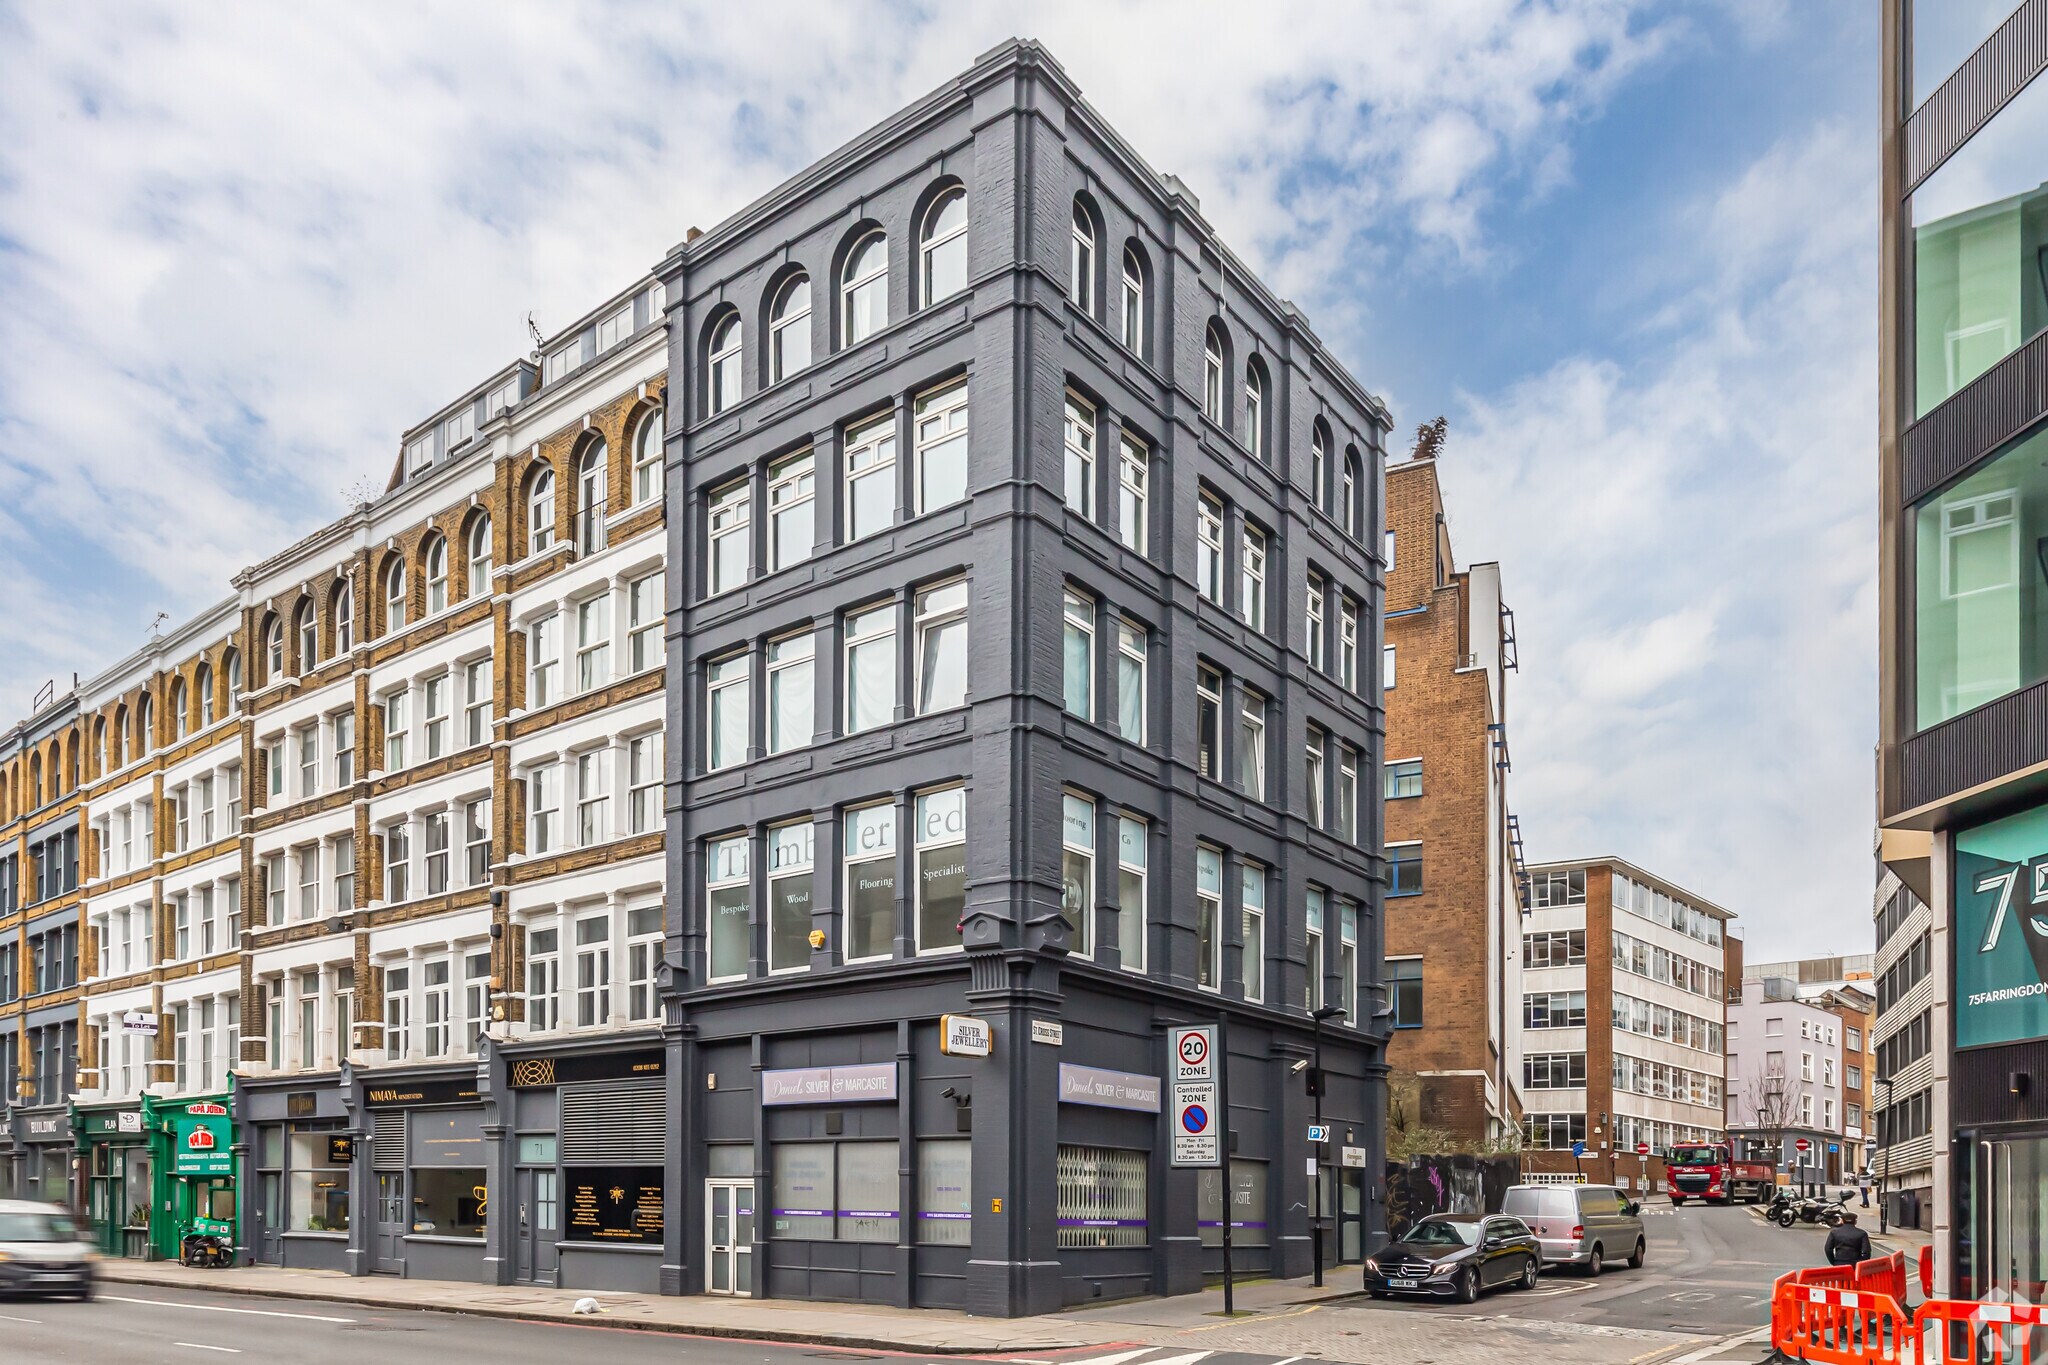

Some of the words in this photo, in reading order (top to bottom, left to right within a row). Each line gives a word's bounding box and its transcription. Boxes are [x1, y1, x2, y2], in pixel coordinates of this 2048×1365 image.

[720, 902, 749, 915] Bespoke
[786, 891, 809, 904] Wood
[860, 877, 894, 890] Flooring
[923, 864, 965, 881] Specialist
[958, 1025, 981, 1038] SILVER
[1038, 1026, 1050, 1037] CROSS
[1050, 1028, 1062, 1039] STREET
[951, 1035, 989, 1049] JEWELLERY
[1183, 1041, 1204, 1056] 20
[1180, 1066, 1207, 1076] ZONE
[805, 1080, 829, 1094] SILVER
[831, 1078, 844, 1093] &
[845, 1076, 888, 1091] MARCASITE
[1176, 1085, 1212, 1094] Controlled
[369, 1089, 398, 1101] NIMAYA
[1095, 1083, 1115, 1097] SILVER
[1115, 1085, 1126, 1099] &
[1126, 1087, 1156, 1103] MARCASITE
[1182, 1094, 1207, 1103] ZONE
[189, 1105, 205, 1114] PAPA
[30, 1120, 57, 1134] BUILDING
[104, 1119, 117, 1130] PLAN
[534, 1143, 543, 1156] 71
